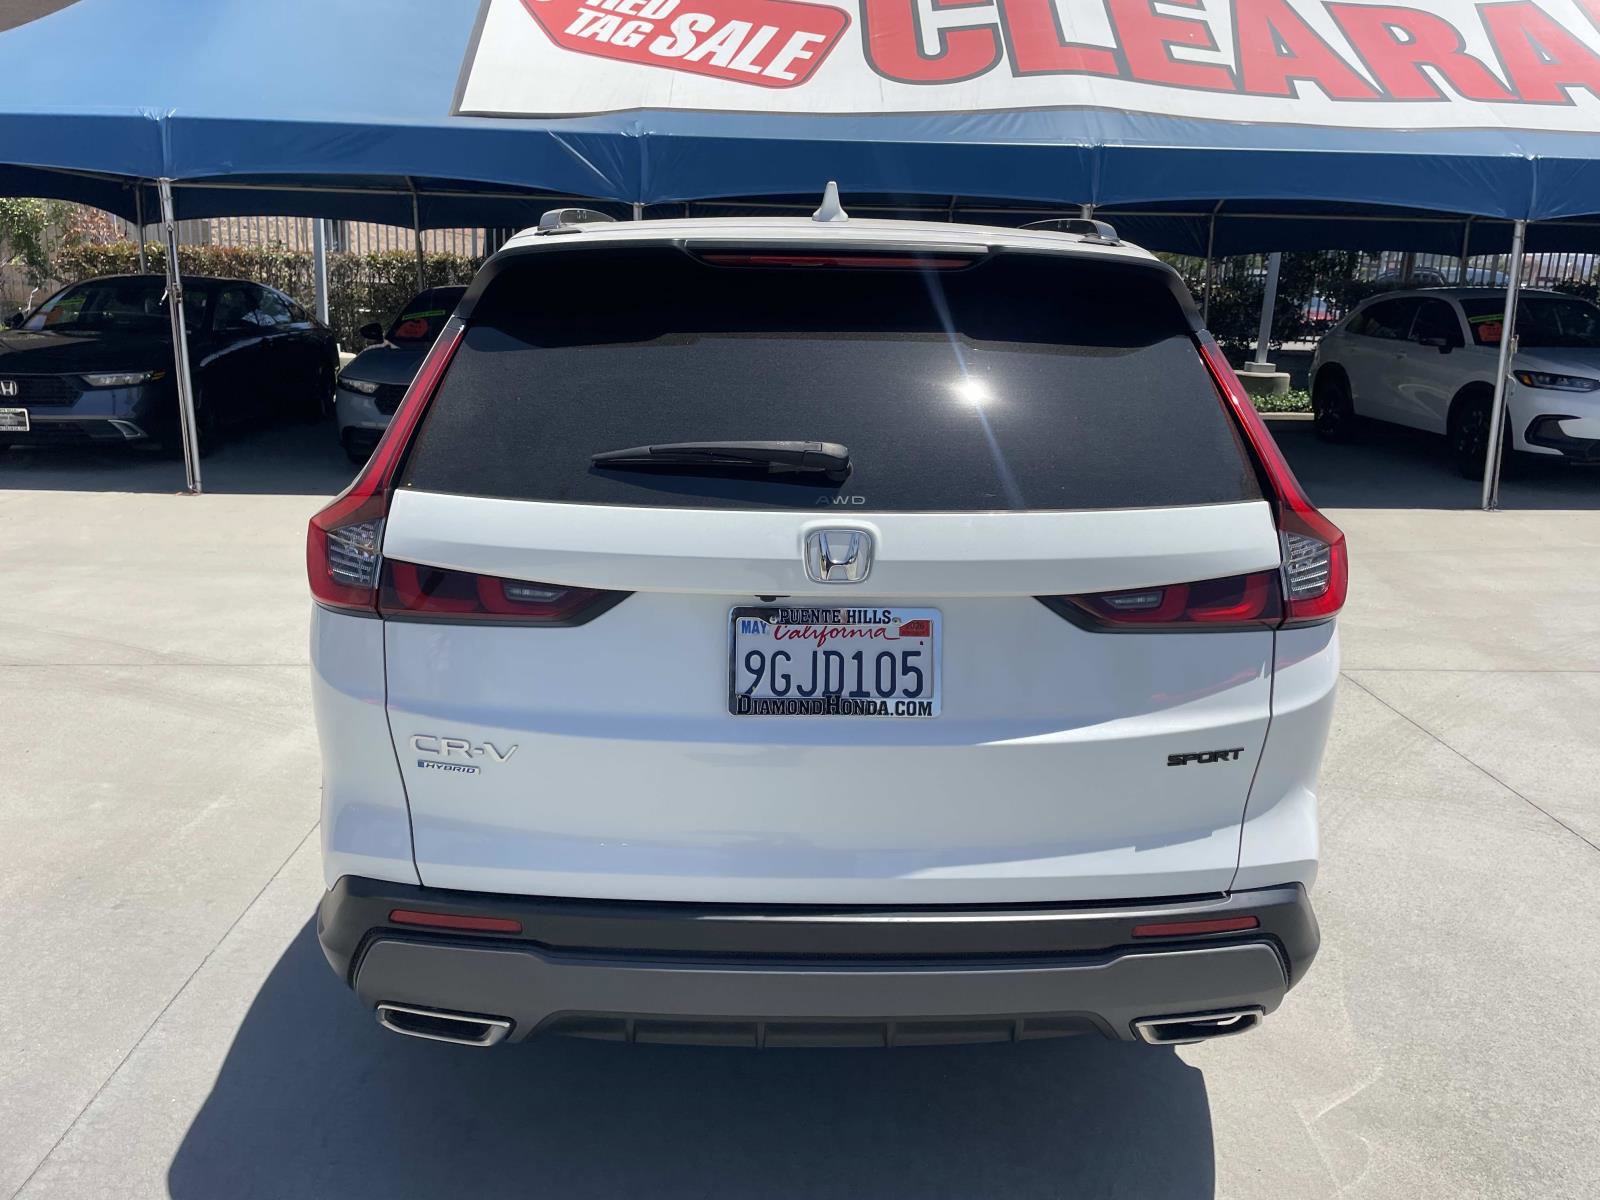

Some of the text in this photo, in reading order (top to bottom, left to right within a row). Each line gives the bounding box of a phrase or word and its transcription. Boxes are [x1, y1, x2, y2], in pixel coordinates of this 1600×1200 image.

[564, 7, 826, 81] TAG SALE
[859, 0, 1600, 107] CLEARA
[816, 495, 865, 505] AWD
[778, 609, 892, 625] PUENTE HILLS
[741, 620, 767, 634] MAY
[774, 624, 900, 647] California
[744, 650, 924, 699] 9GJD105
[410, 734, 519, 763] CR-V
[1167, 747, 1245, 767] SPORT
[425, 762, 476, 774] HYBRID
